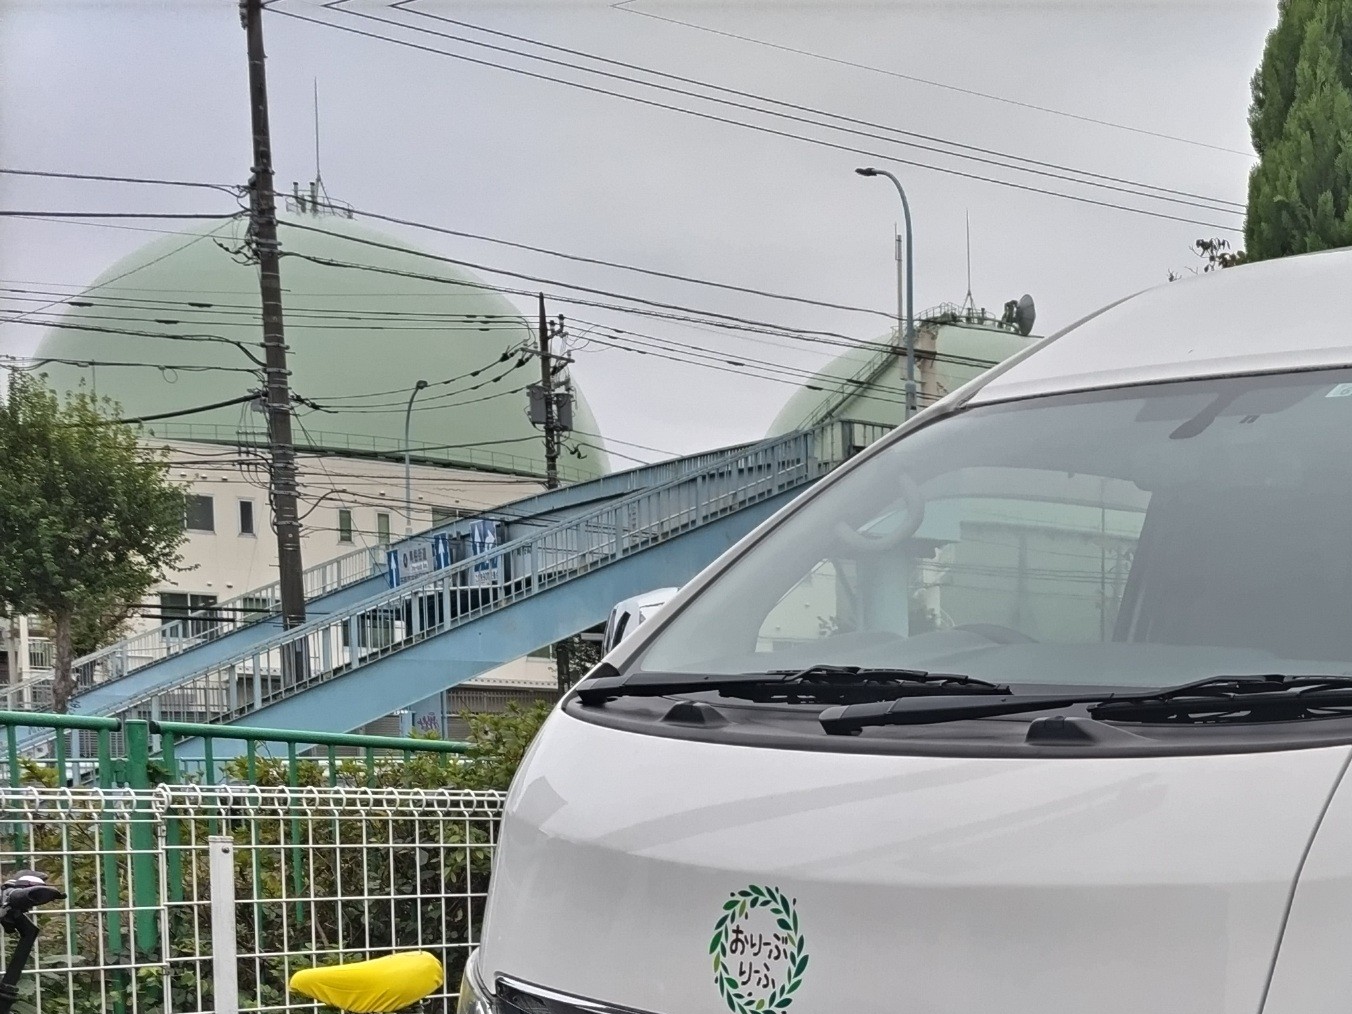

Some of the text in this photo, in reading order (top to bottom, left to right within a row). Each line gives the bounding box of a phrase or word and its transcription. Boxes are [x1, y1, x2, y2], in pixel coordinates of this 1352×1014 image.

[729, 924, 789, 961] おりーぶ
[738, 961, 776, 989] りーふ
